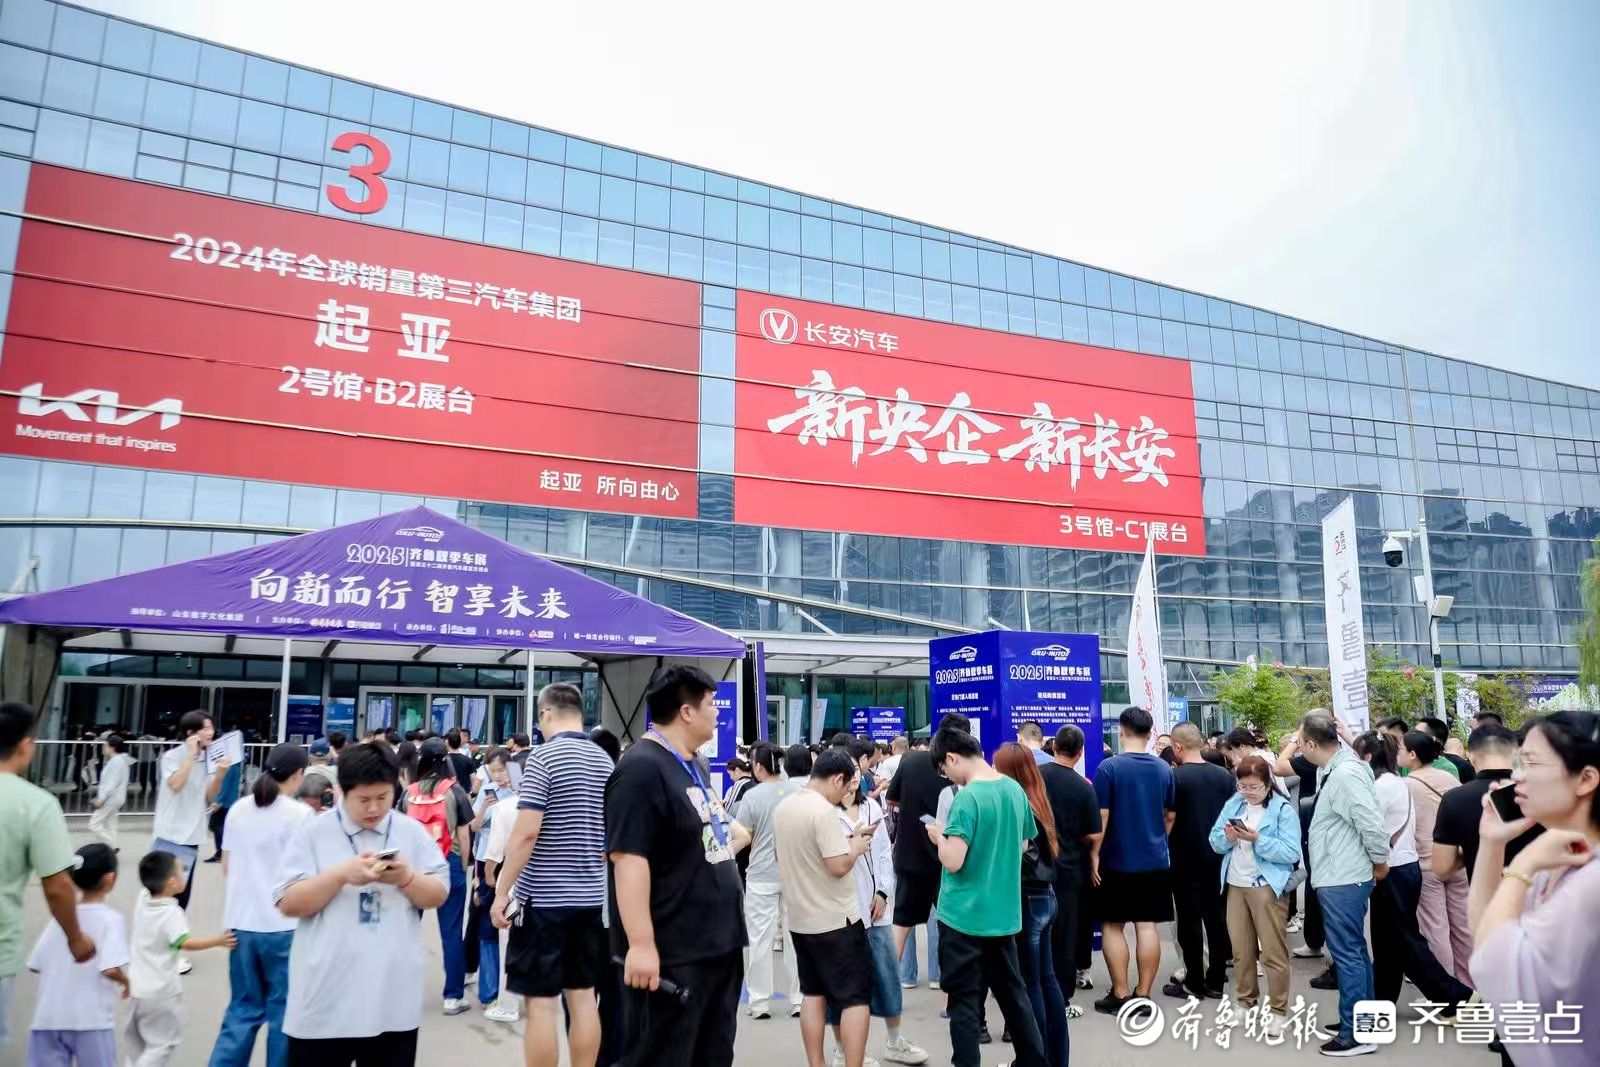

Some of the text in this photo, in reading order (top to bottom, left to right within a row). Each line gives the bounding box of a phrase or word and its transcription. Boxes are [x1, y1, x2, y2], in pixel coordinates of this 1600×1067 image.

[326, 131, 391, 214] 3
[169, 233, 582, 322] 2024年全球销量第三汽车集团
[803, 321, 899, 353] 长安汽车
[18, 382, 183, 431] KIA
[15, 424, 177, 452] Movement that inspires
[539, 469, 680, 501] 起亚 所向由心
[1059, 515, 1188, 543] 3号馆-C1展台
[346, 543, 405, 566] 2025
[250, 568, 571, 619] 向新而行 智享未来
[935, 668, 959, 685] 2025
[1009, 665, 1043, 680] 2025
